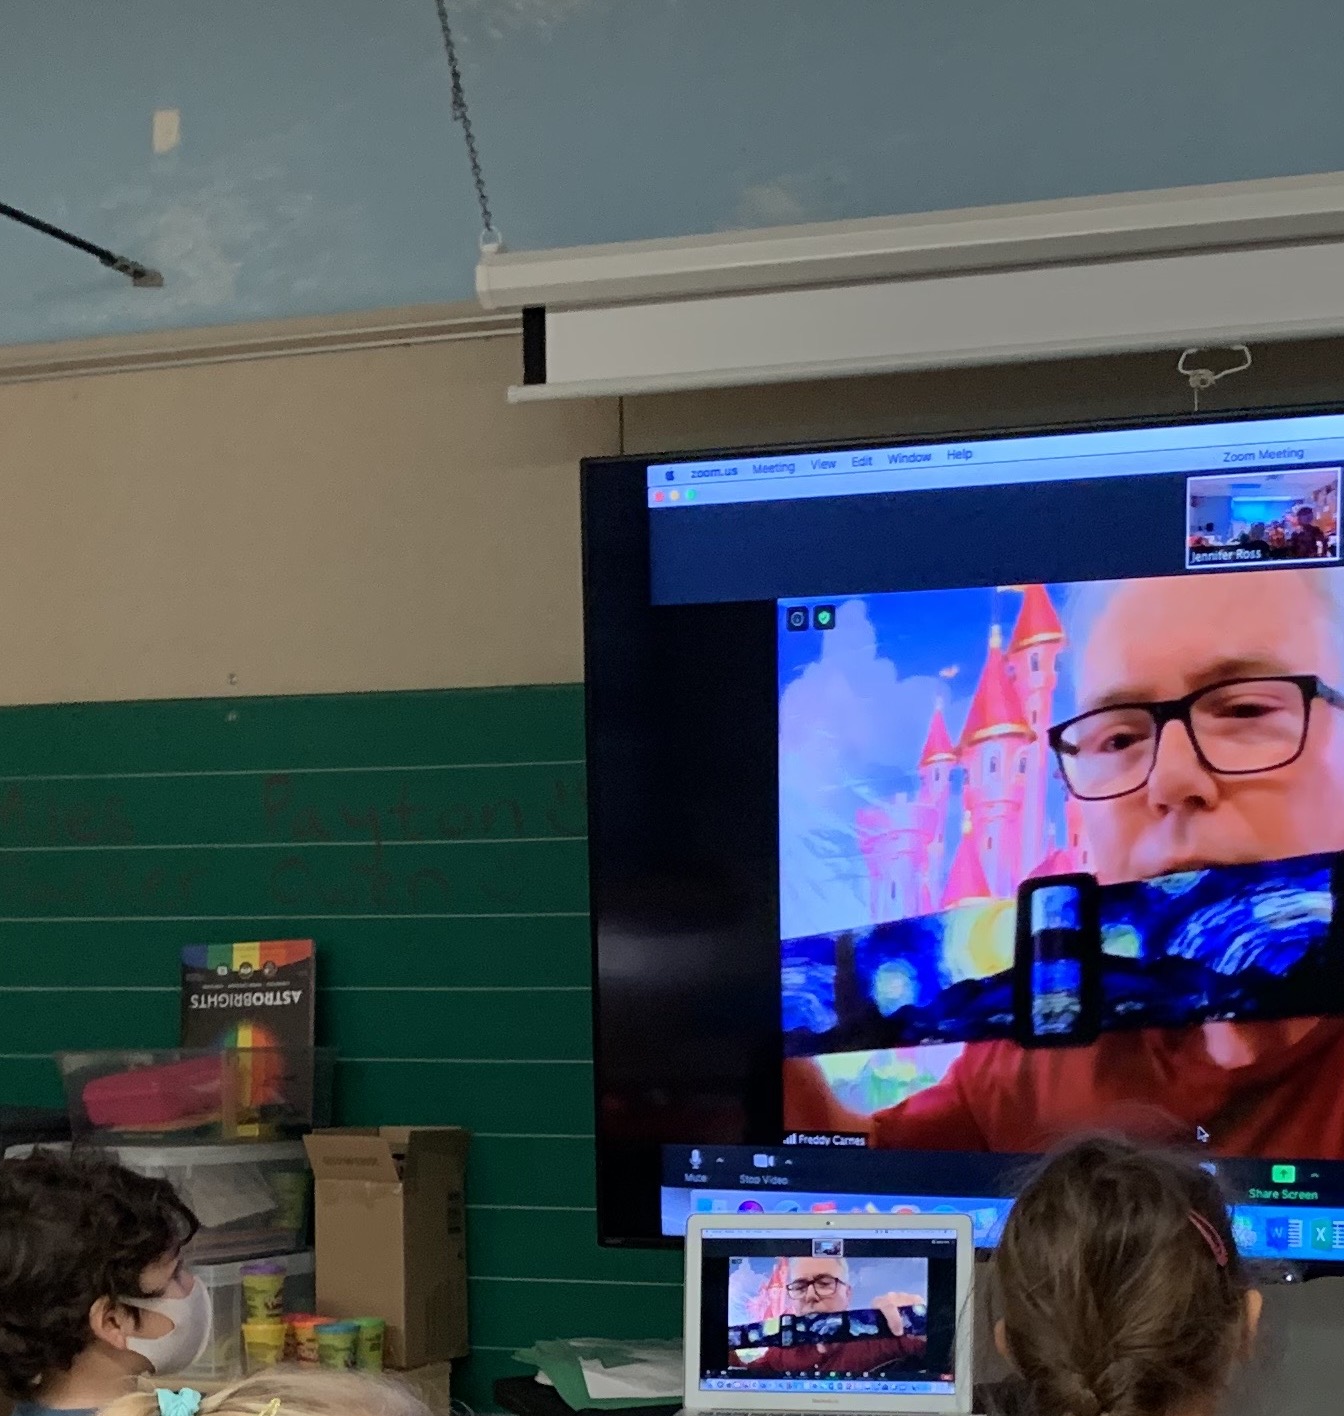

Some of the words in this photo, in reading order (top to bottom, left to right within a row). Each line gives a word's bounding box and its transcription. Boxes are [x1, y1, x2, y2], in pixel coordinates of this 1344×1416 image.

[1223, 452, 1256, 463] Zoom
[1258, 447, 1305, 460] Meeting
[690, 465, 738, 479] zoom.us
[752, 461, 796, 475] Meeting
[810, 458, 837, 470] View
[851, 455, 873, 467] Edit
[887, 451, 932, 464] Window
[947, 448, 973, 462] Help
[1190, 550, 1233, 564] Jennifer
[1236, 548, 1262, 560] Ross
[189, 989, 303, 1009] ASTROBRIGHTS
[799, 1134, 831, 1147] Freddy
[1248, 1188, 1279, 1200] Share
[1282, 1189, 1319, 1200] Screen
[1315, 1226, 1327, 1242] X
